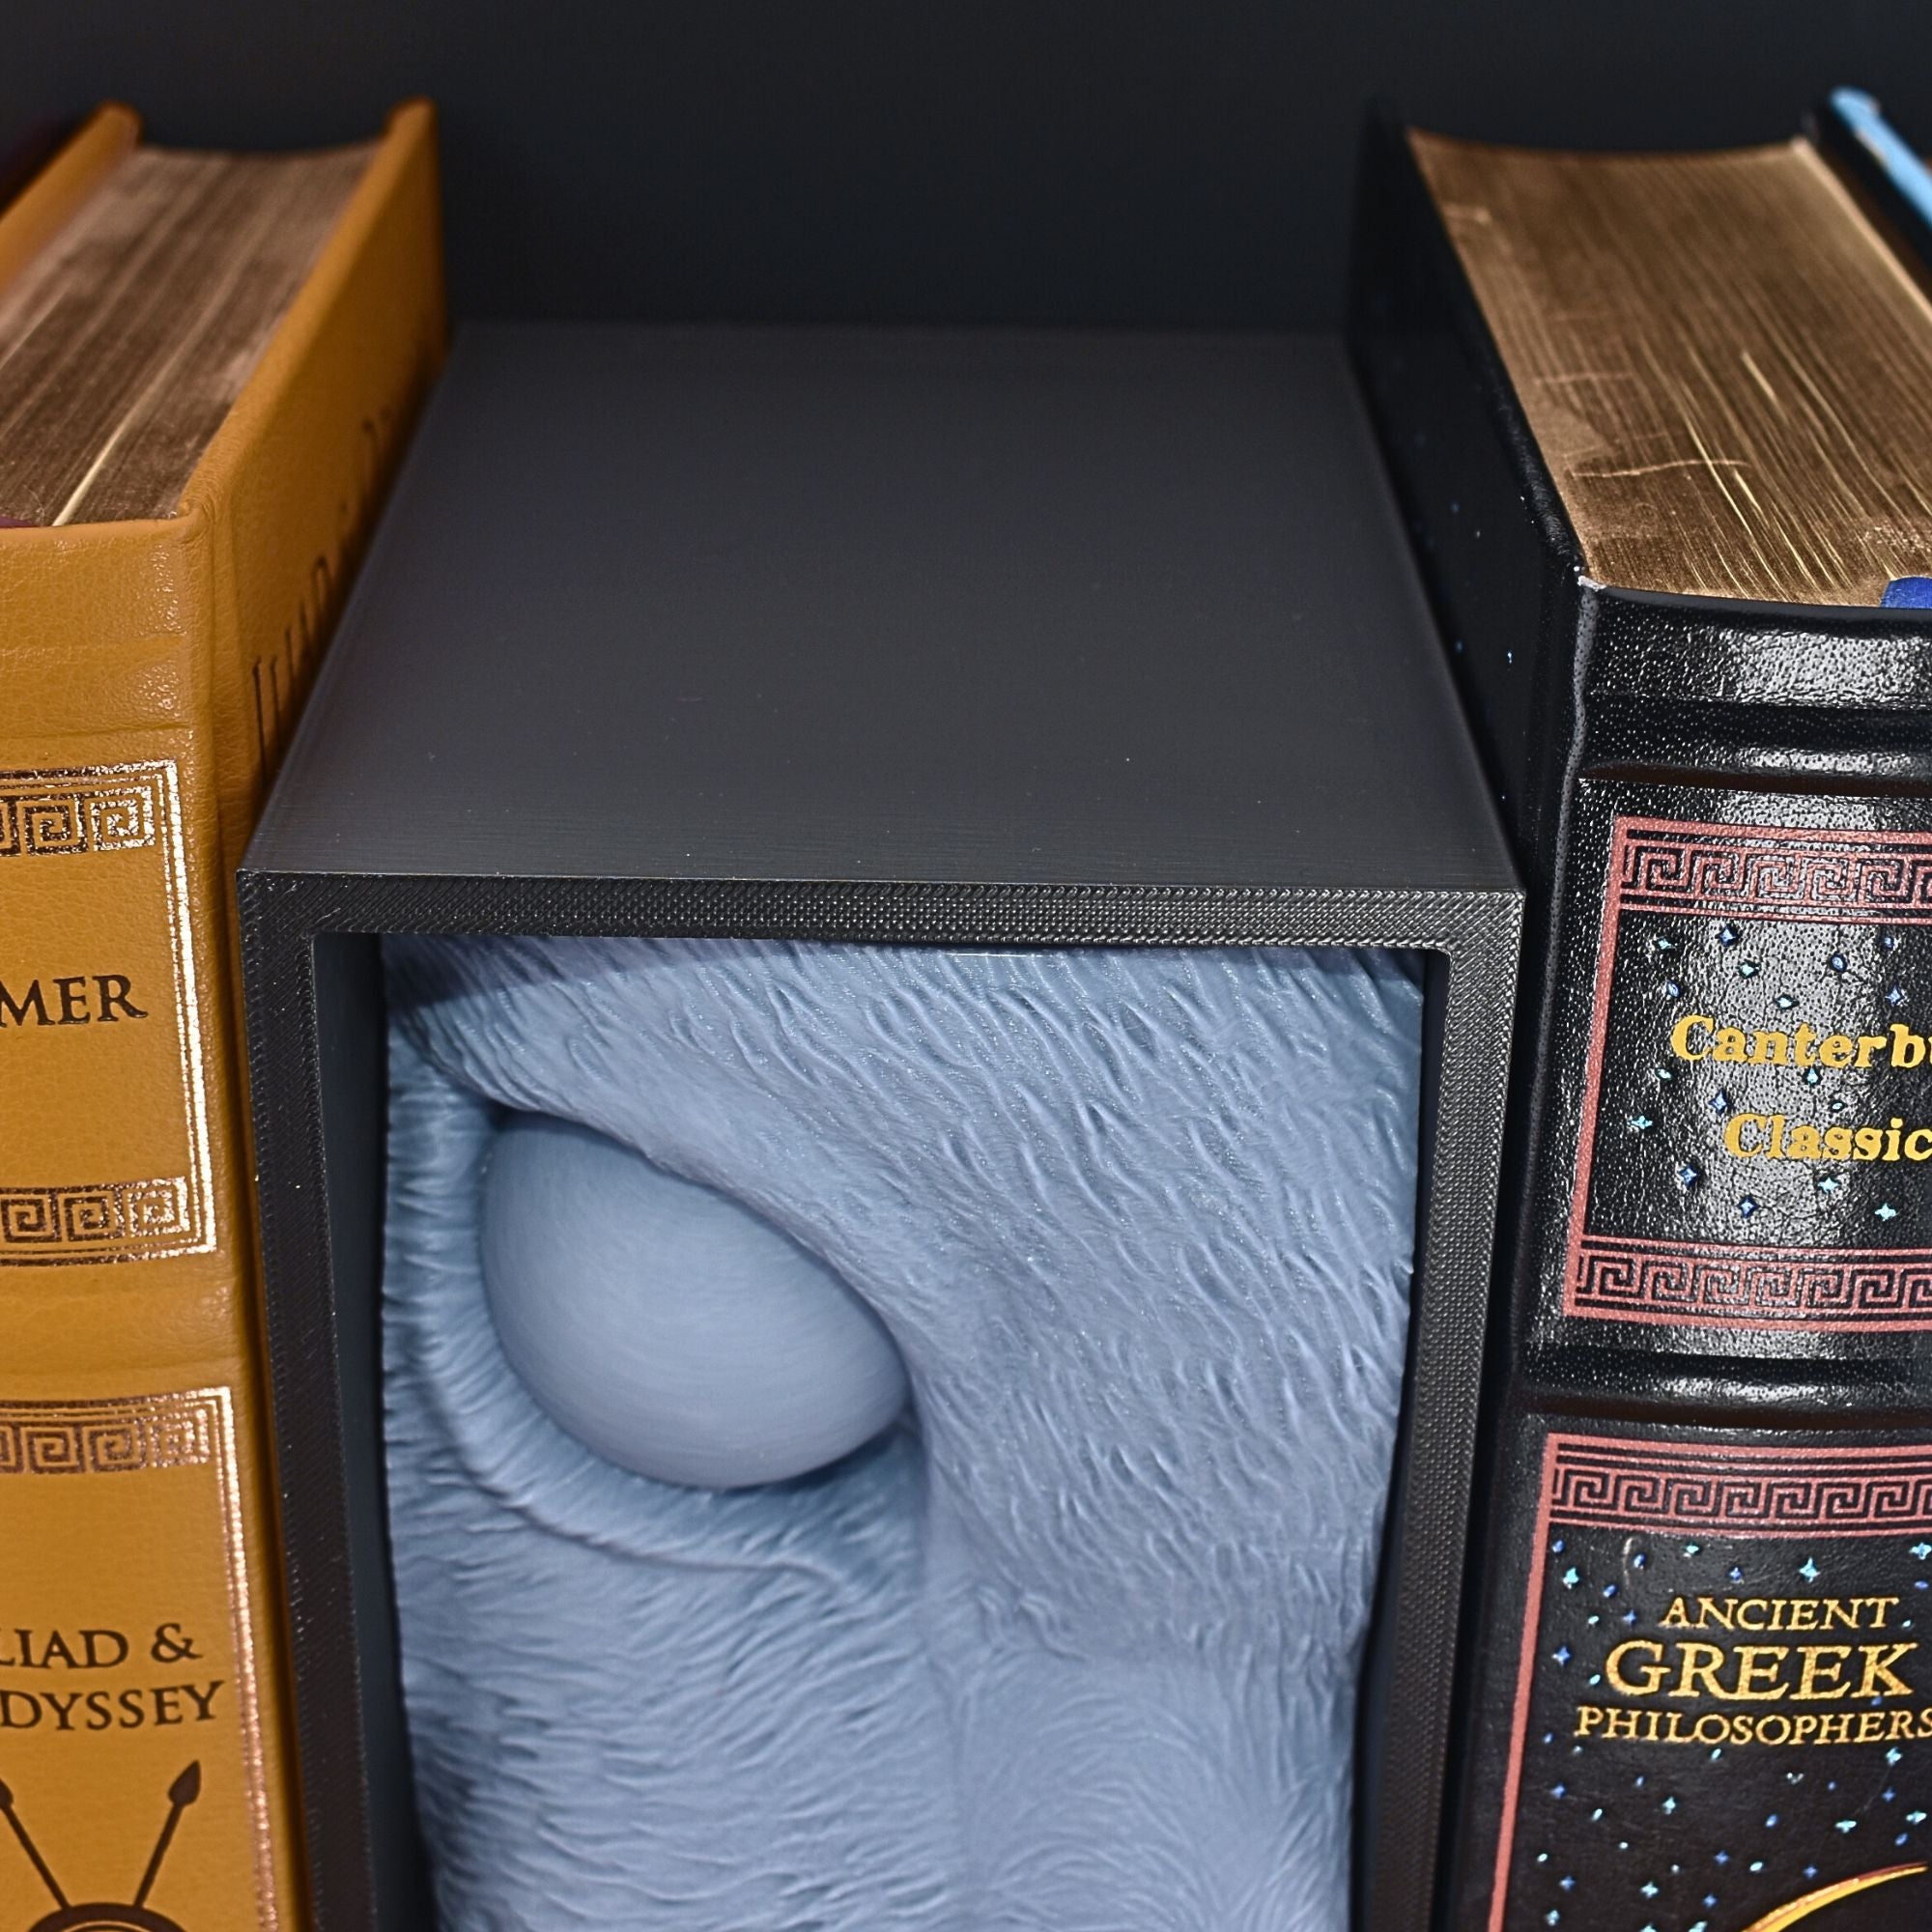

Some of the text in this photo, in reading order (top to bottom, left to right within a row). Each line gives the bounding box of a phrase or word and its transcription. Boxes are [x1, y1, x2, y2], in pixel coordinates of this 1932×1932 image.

[0, 975, 149, 1028] MER
[1670, 1015, 1932, 1068] Canterb
[1724, 1114, 1932, 1161] Classic
[1659, 1597, 1899, 1631] ANCIENT
[151, 1623, 204, 1663] &
[1605, 1640, 1918, 1700] GREEK
[0, 1680, 225, 1731] DYSSEY
[1574, 1706, 1932, 1746] PHILOSOPHERS
